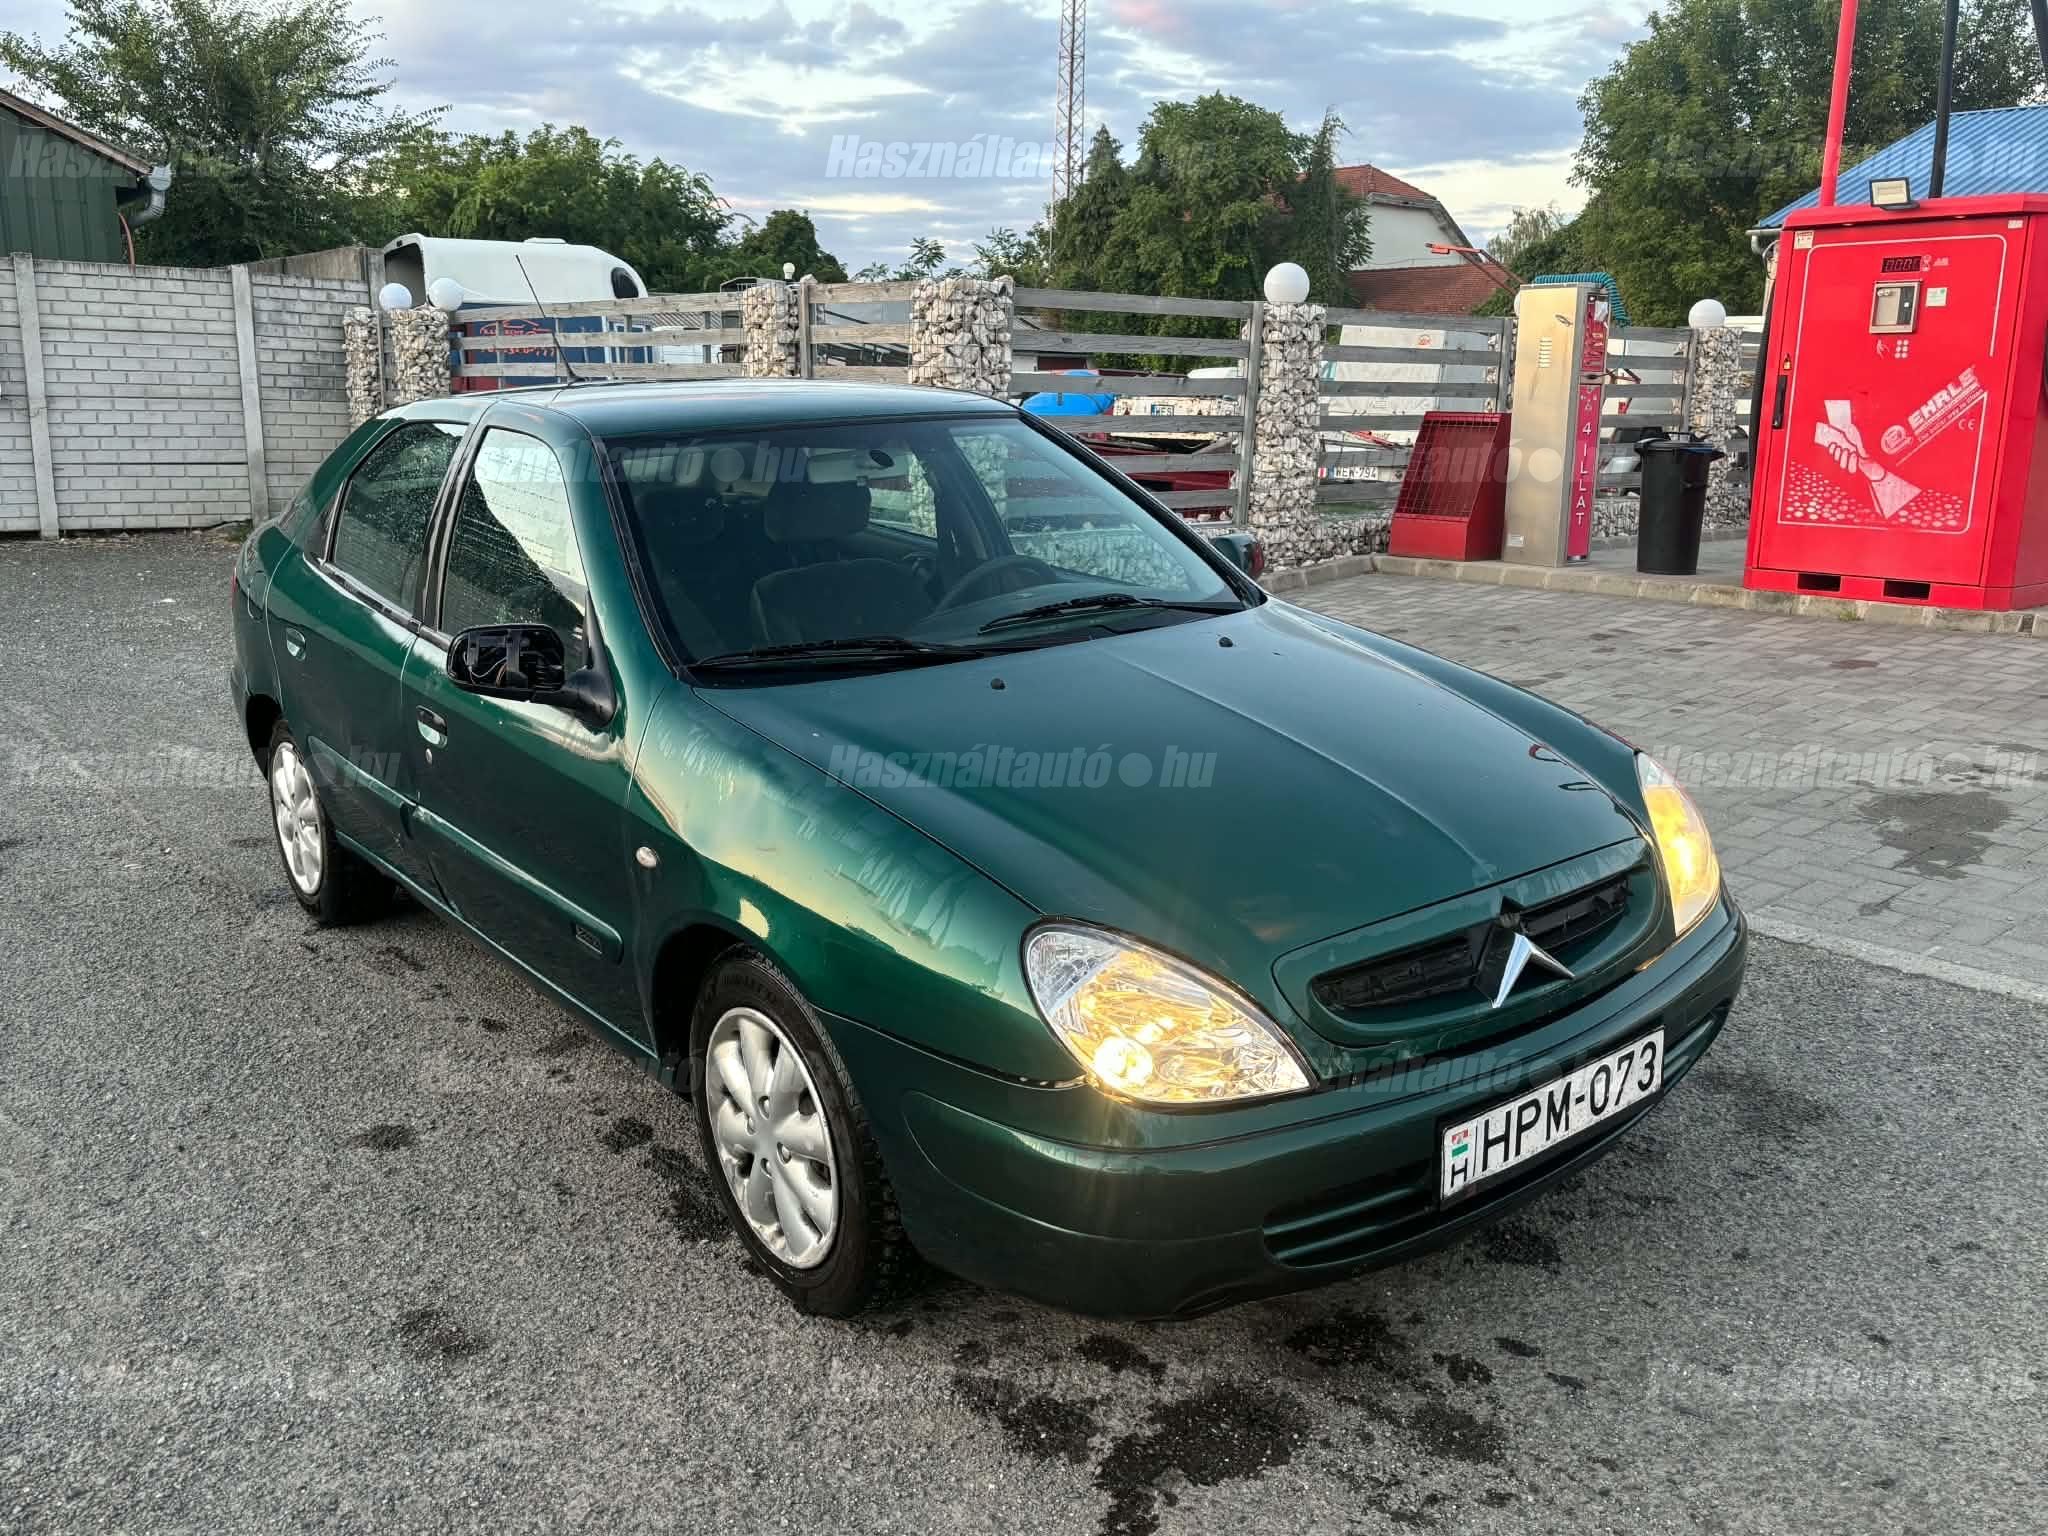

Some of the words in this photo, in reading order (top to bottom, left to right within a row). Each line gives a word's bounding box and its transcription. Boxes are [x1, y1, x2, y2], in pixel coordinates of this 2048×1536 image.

[1908, 367, 1978, 430] EHRLE
[1582, 422, 1592, 435] 4
[1481, 1041, 1656, 1172] HPM-073
[1450, 1158, 1468, 1189] H
